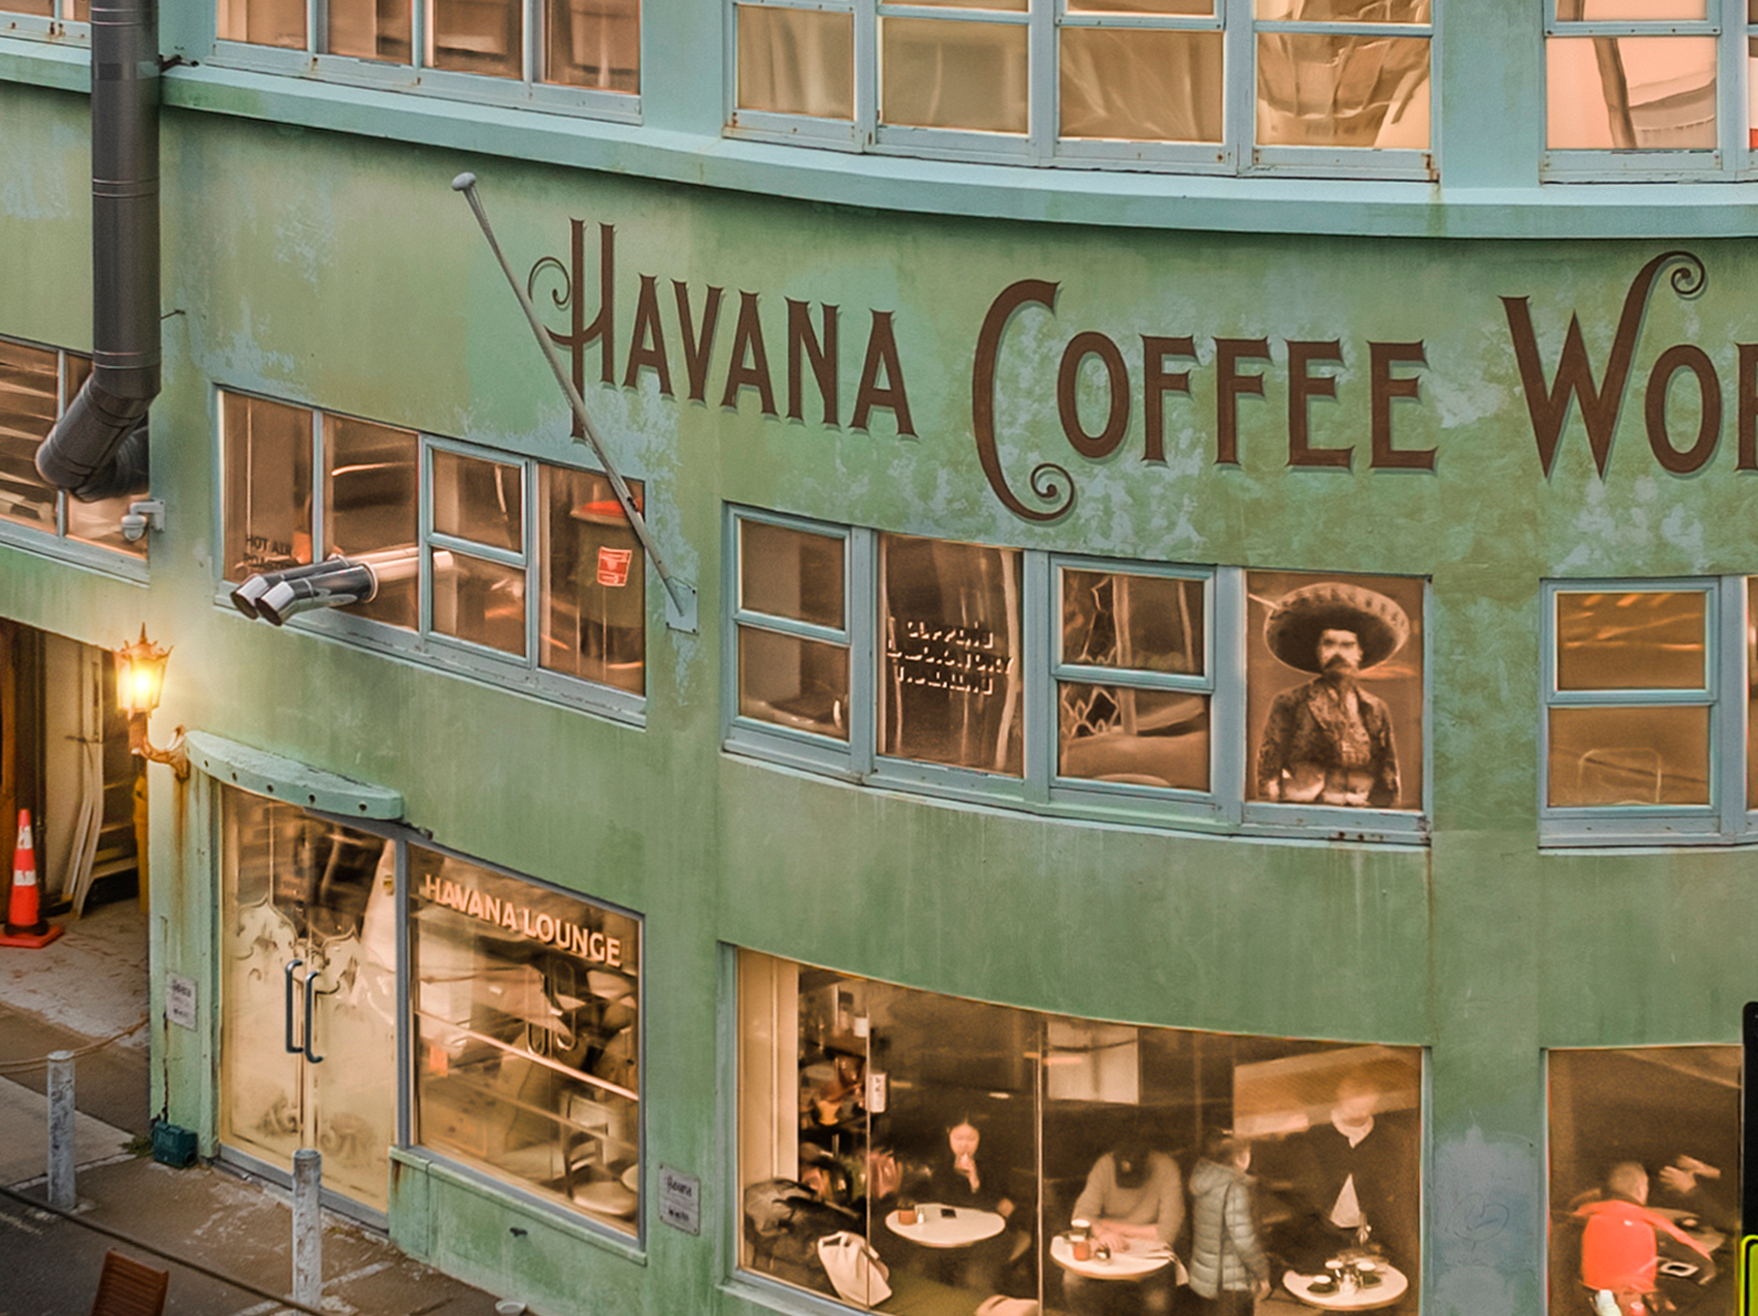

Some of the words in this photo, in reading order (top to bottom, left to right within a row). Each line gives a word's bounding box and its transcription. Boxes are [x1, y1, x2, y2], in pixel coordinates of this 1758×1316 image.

[528, 218, 920, 441] HAVANA
[971, 278, 1441, 522] COFFEE
[424, 873, 518, 932] HAVANA
[522, 907, 622, 968] LOUNGE
